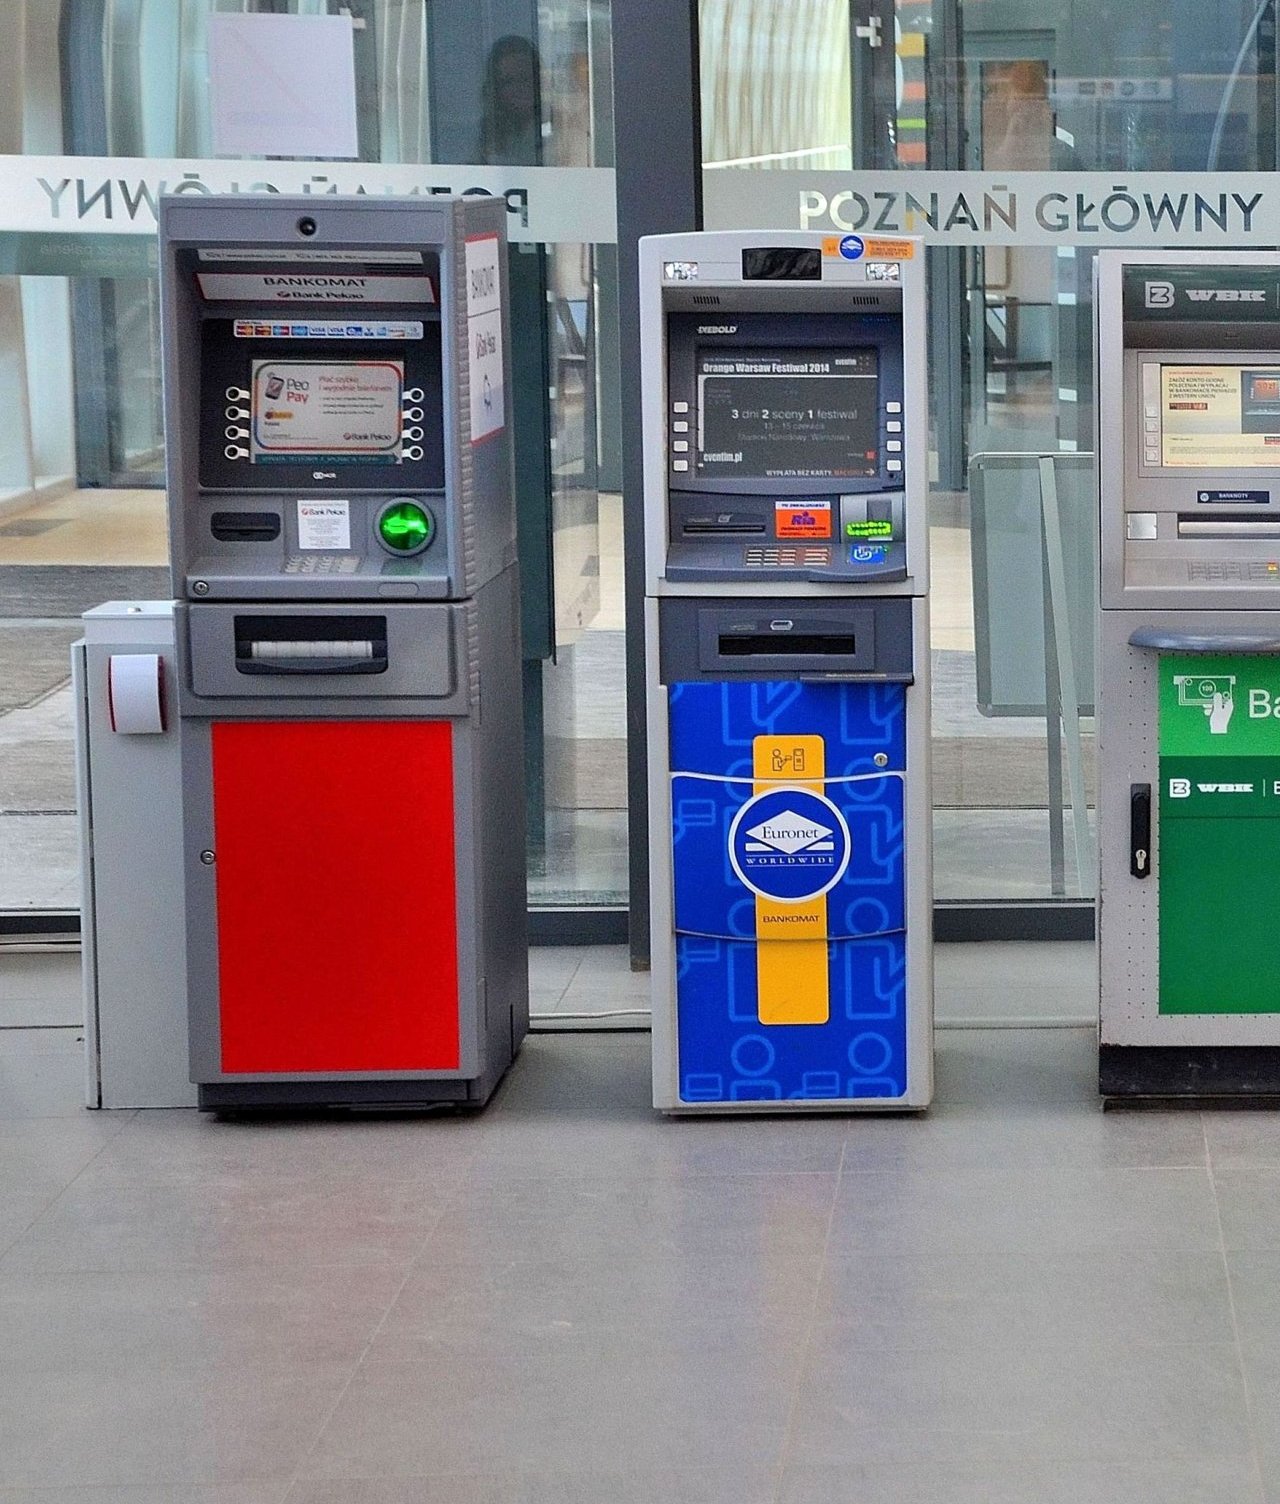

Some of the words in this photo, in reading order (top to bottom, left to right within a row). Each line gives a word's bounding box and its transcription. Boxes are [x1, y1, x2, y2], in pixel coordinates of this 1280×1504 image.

[263, 277, 367, 287] BANKOMAT
[292, 291, 323, 299] Bank
[325, 291, 364, 299] Pekao
[1186, 290, 1266, 302] WBK
[703, 363, 735, 374] Orange
[735, 363, 771, 373] Warsaw
[809, 362, 830, 373] 2014
[286, 378, 310, 391] Peo
[286, 391, 310, 405] Pay
[731, 409, 739, 419] 3
[741, 409, 759, 419] dni
[761, 409, 770, 419] 2
[772, 411, 804, 421] sceny
[807, 409, 814, 419] 1
[703, 451, 743, 463] eventim.pl
[791, 511, 816, 526] Ria
[761, 826, 818, 840] Euronet
[745, 856, 835, 865] WORLDWIDE
[762, 914, 821, 923] BANKOMAT
